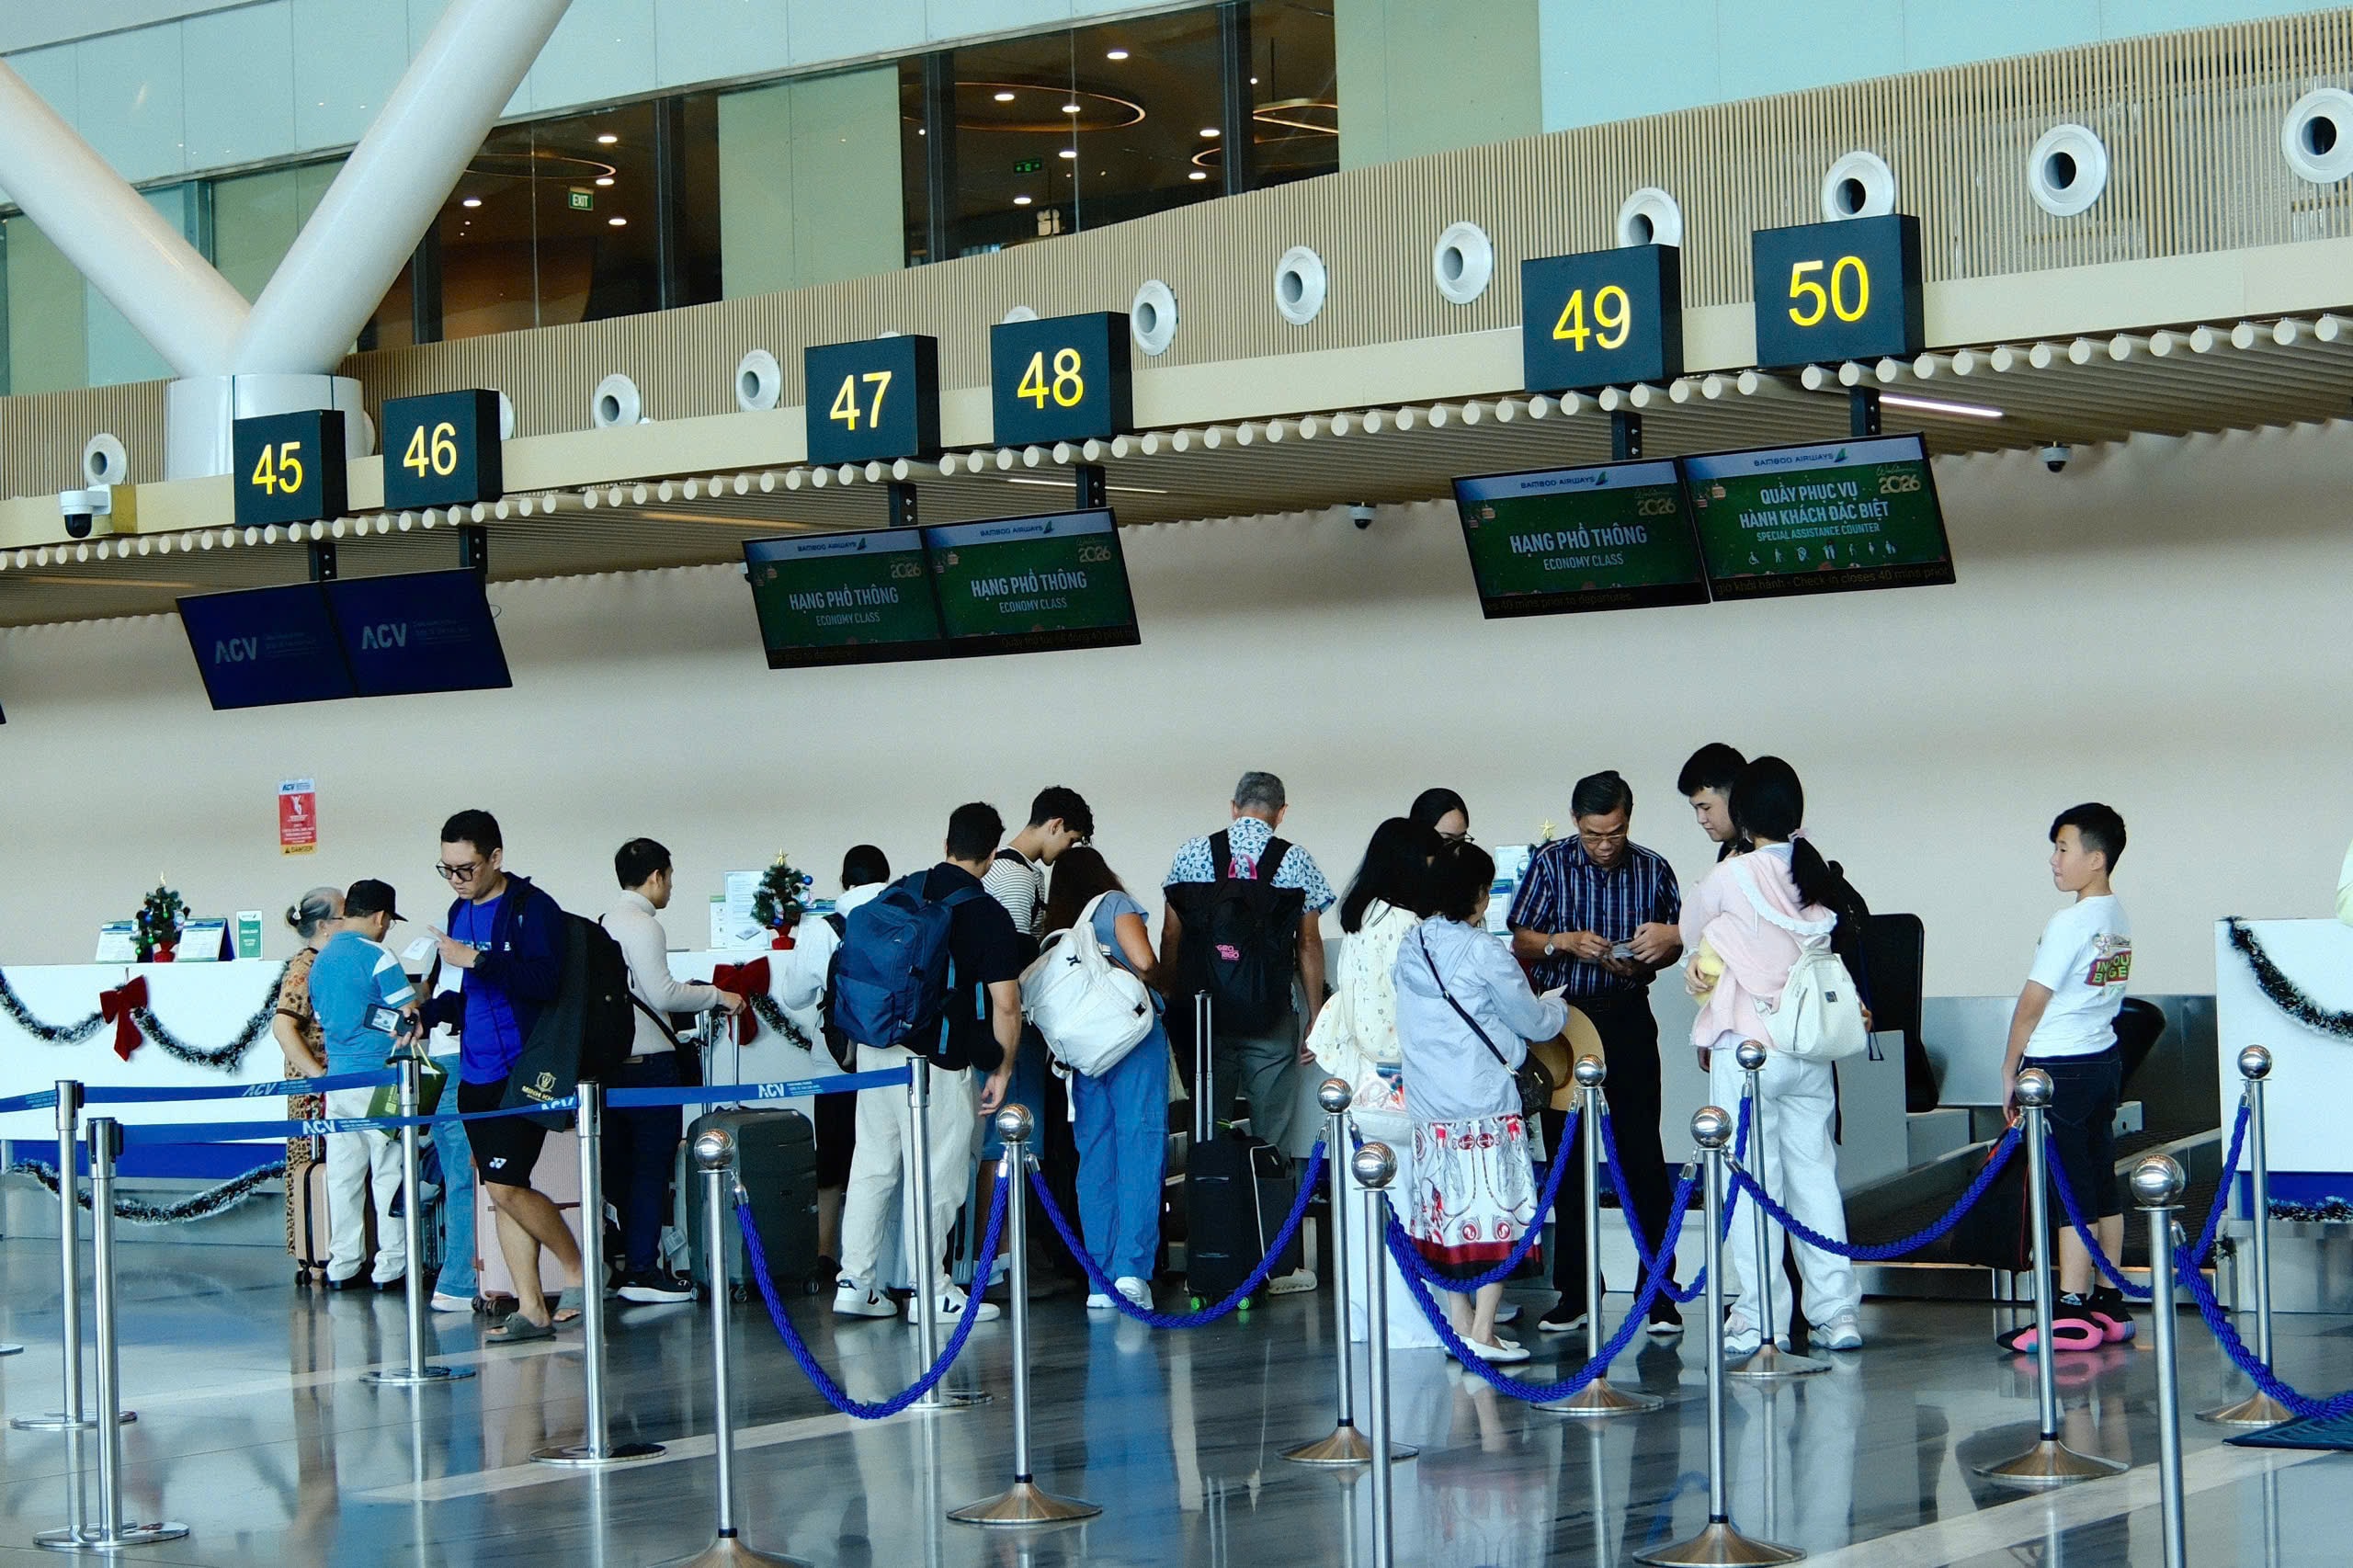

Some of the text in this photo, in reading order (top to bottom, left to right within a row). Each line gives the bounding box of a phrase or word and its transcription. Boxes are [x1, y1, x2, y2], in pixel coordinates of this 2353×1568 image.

[1789, 256, 1870, 326] 50
[1552, 285, 1631, 352] 49
[1017, 347, 1084, 409] 48
[829, 370, 892, 430] 47
[403, 422, 458, 478] 46
[1754, 453, 1834, 467] BAMBOO AIRWAYS
[252, 441, 302, 494] 45
[1521, 476, 1595, 489] BAMBOO AIRWAYS
[1799, 483, 1836, 504] PHỤC
[1837, 481, 1859, 501] VỤ
[1878, 474, 1921, 494] 2026
[1637, 497, 1677, 516] 2026
[1739, 497, 1889, 528] HÀNH KHÁCH ĐẶC BIỆT
[1510, 521, 1647, 558] HẠNG PHỔ THÔNG
[1756, 522, 1881, 542] SPECIAL ASSISTANCE COUNTER
[1078, 546, 1111, 562] 2026
[1544, 552, 1623, 571] ECONOMY CLASS
[891, 562, 921, 578] 2026
[971, 567, 1087, 601] HẠNG PHỔ THÔNG
[789, 583, 899, 614] HẠNG PHỔ THÔNG
[999, 597, 1067, 614] ECONOMY CLASS
[816, 611, 880, 626] ECONOMY CLASS
[361, 622, 407, 650] ACV
[215, 637, 256, 664] ACV
[242, 1084, 277, 1097] ACV
[758, 1083, 785, 1098] ACV
[302, 1119, 336, 1135] ACV
